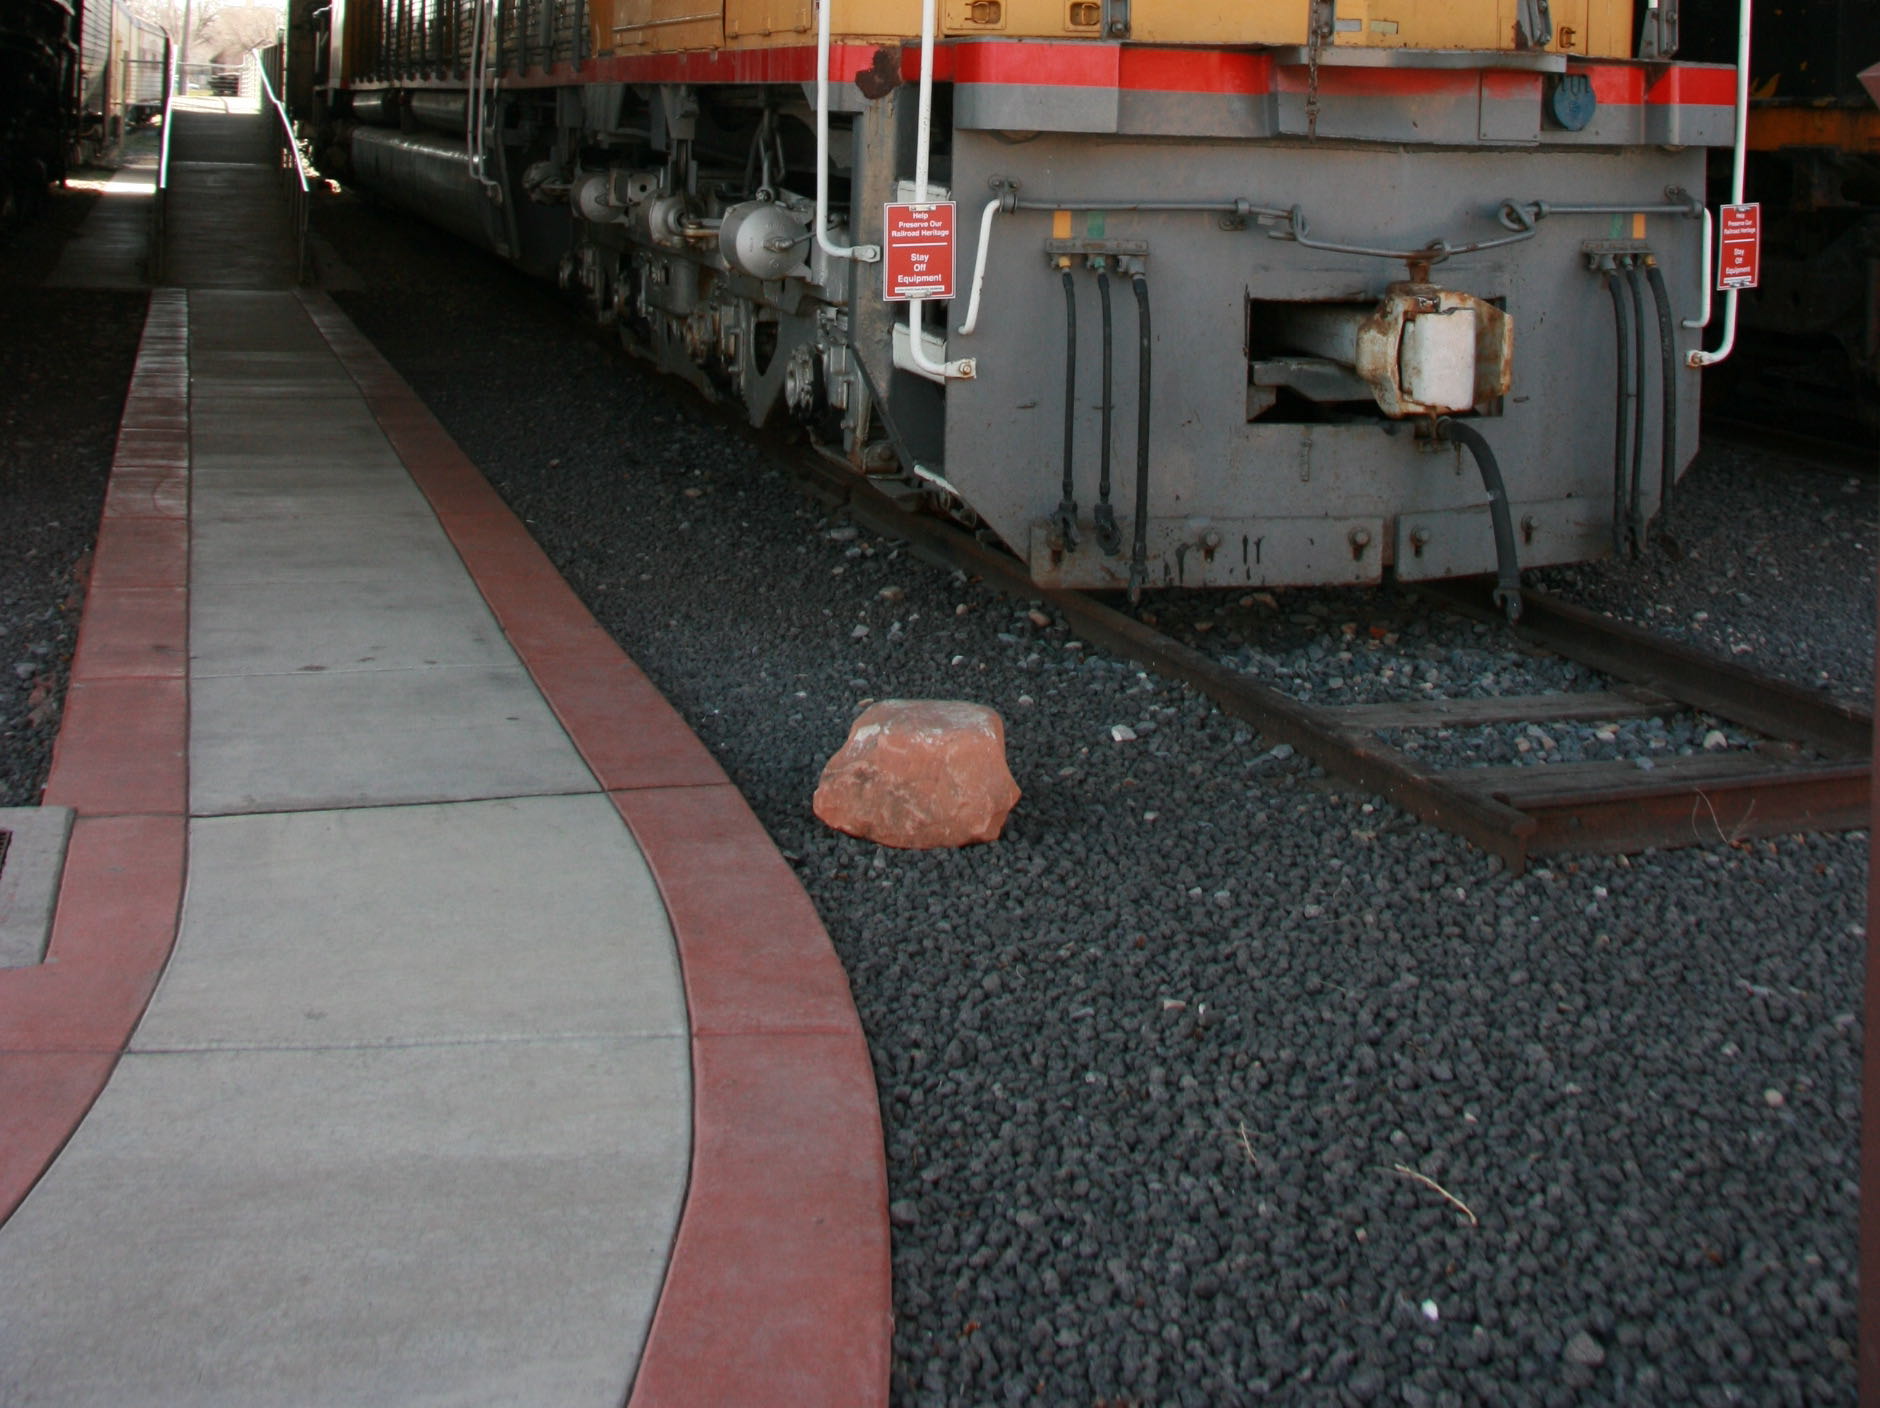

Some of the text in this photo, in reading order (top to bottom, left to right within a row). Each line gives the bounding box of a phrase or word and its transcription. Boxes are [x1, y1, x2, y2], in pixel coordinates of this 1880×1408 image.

[911, 254, 929, 262] Stay
[914, 264, 926, 272] Off
[898, 274, 942, 284] Equipment
